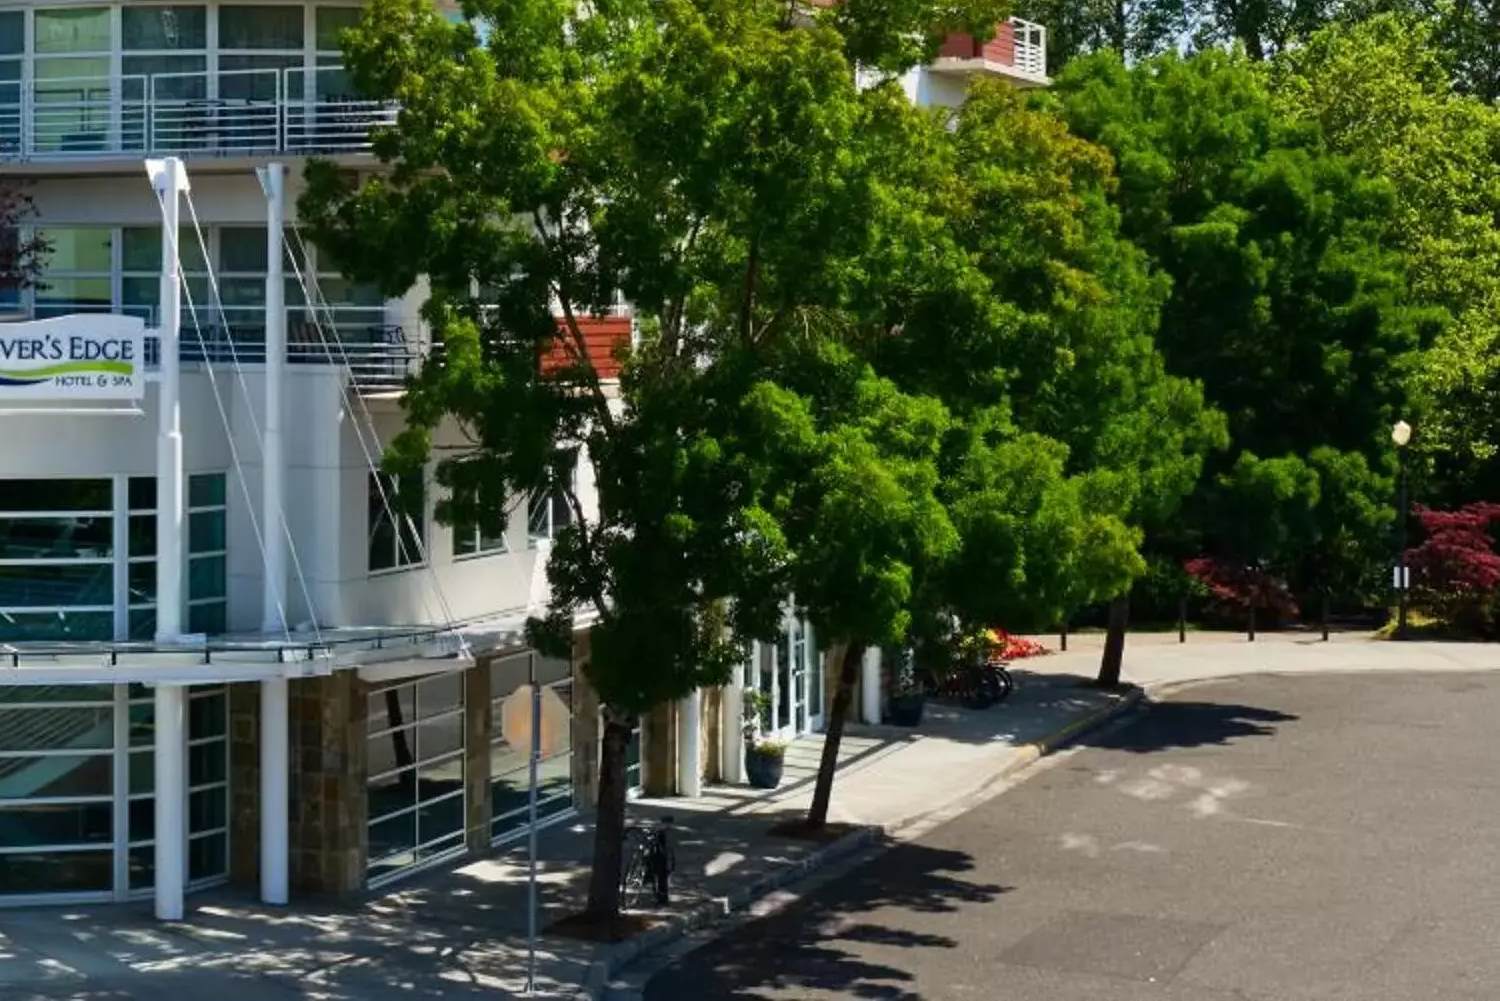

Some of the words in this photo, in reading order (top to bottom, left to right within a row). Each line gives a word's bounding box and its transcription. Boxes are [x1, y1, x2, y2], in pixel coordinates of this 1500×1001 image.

[69, 336, 135, 361] EDGE
[55, 376, 92, 387] HOTEL
[97, 375, 107, 388] &
[112, 376, 133, 387] SPA
